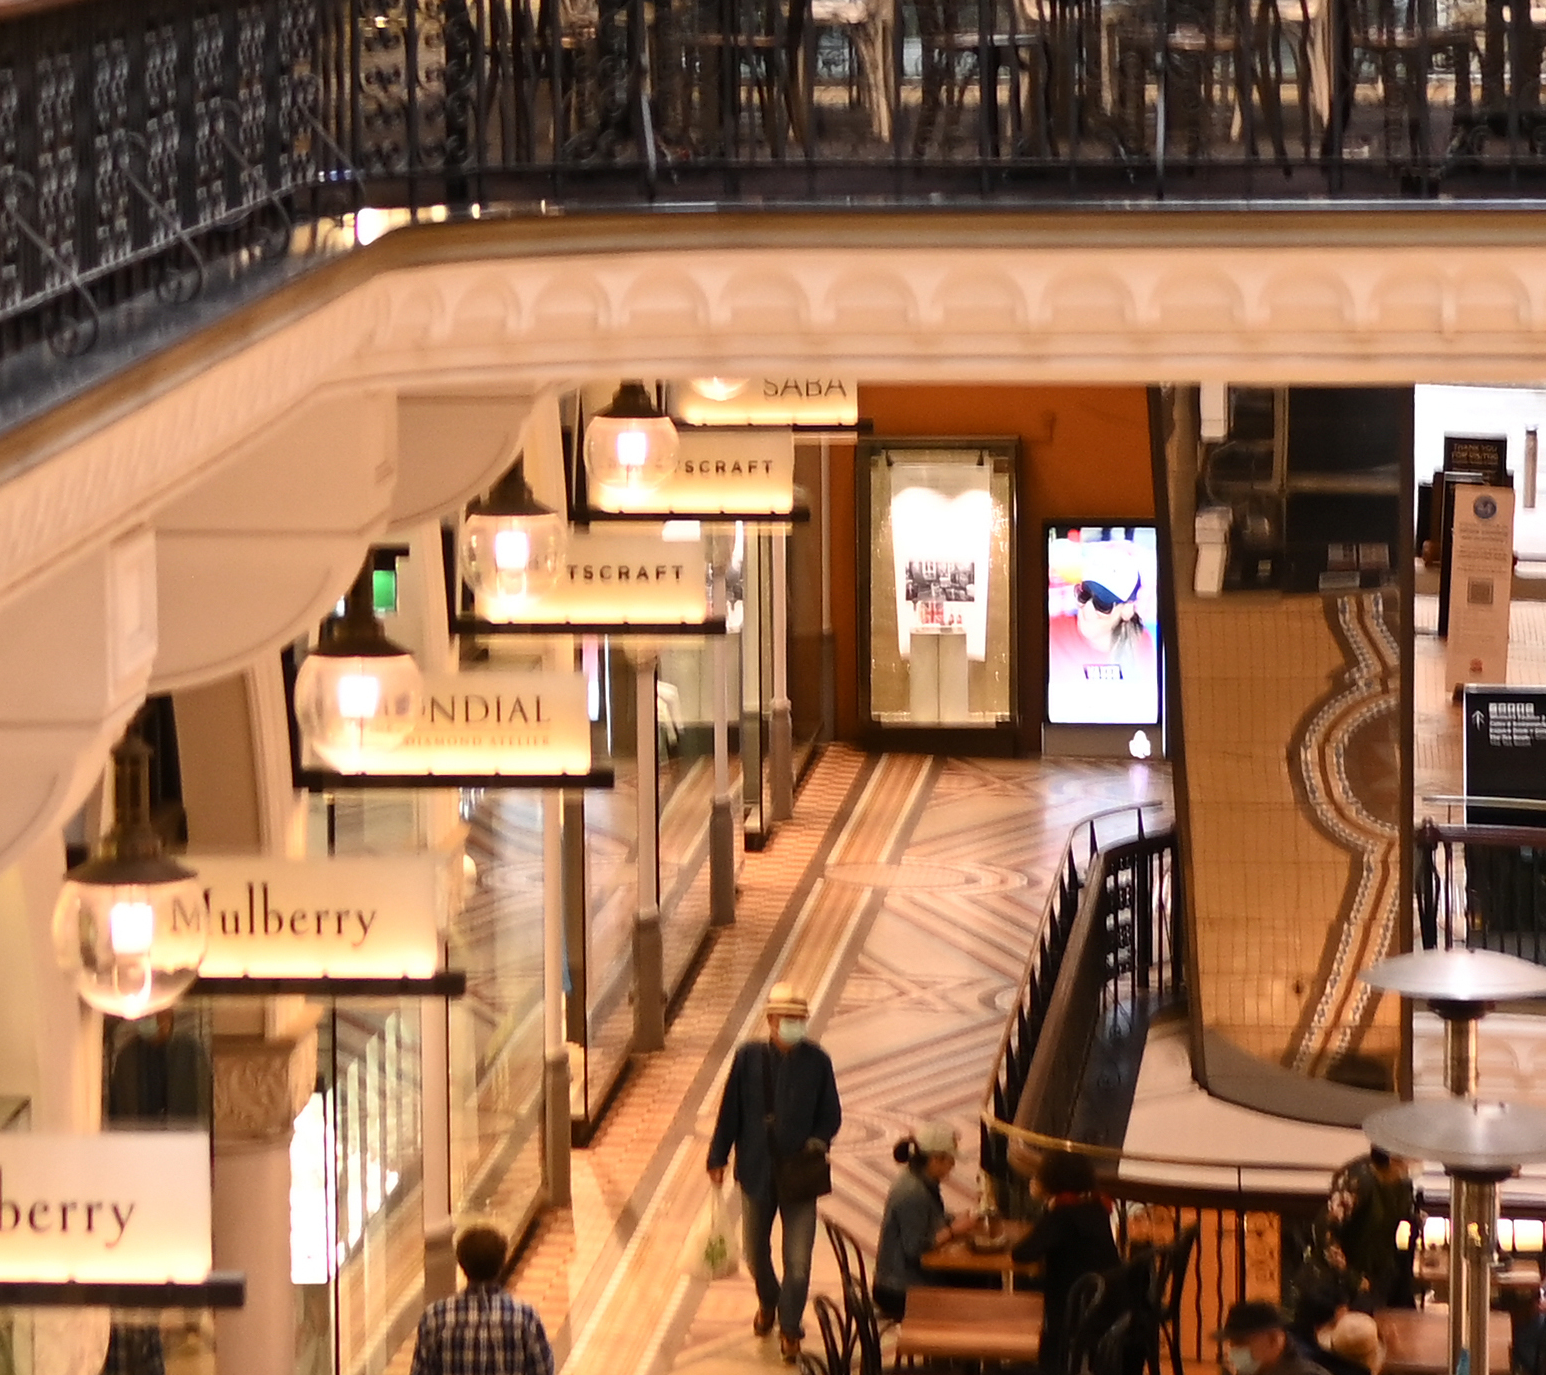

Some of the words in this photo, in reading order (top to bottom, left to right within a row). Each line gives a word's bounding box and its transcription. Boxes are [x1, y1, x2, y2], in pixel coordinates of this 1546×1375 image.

[761, 378, 848, 399] SABA
[416, 694, 551, 724] NDIAL
[172, 882, 377, 948] Mulberry
